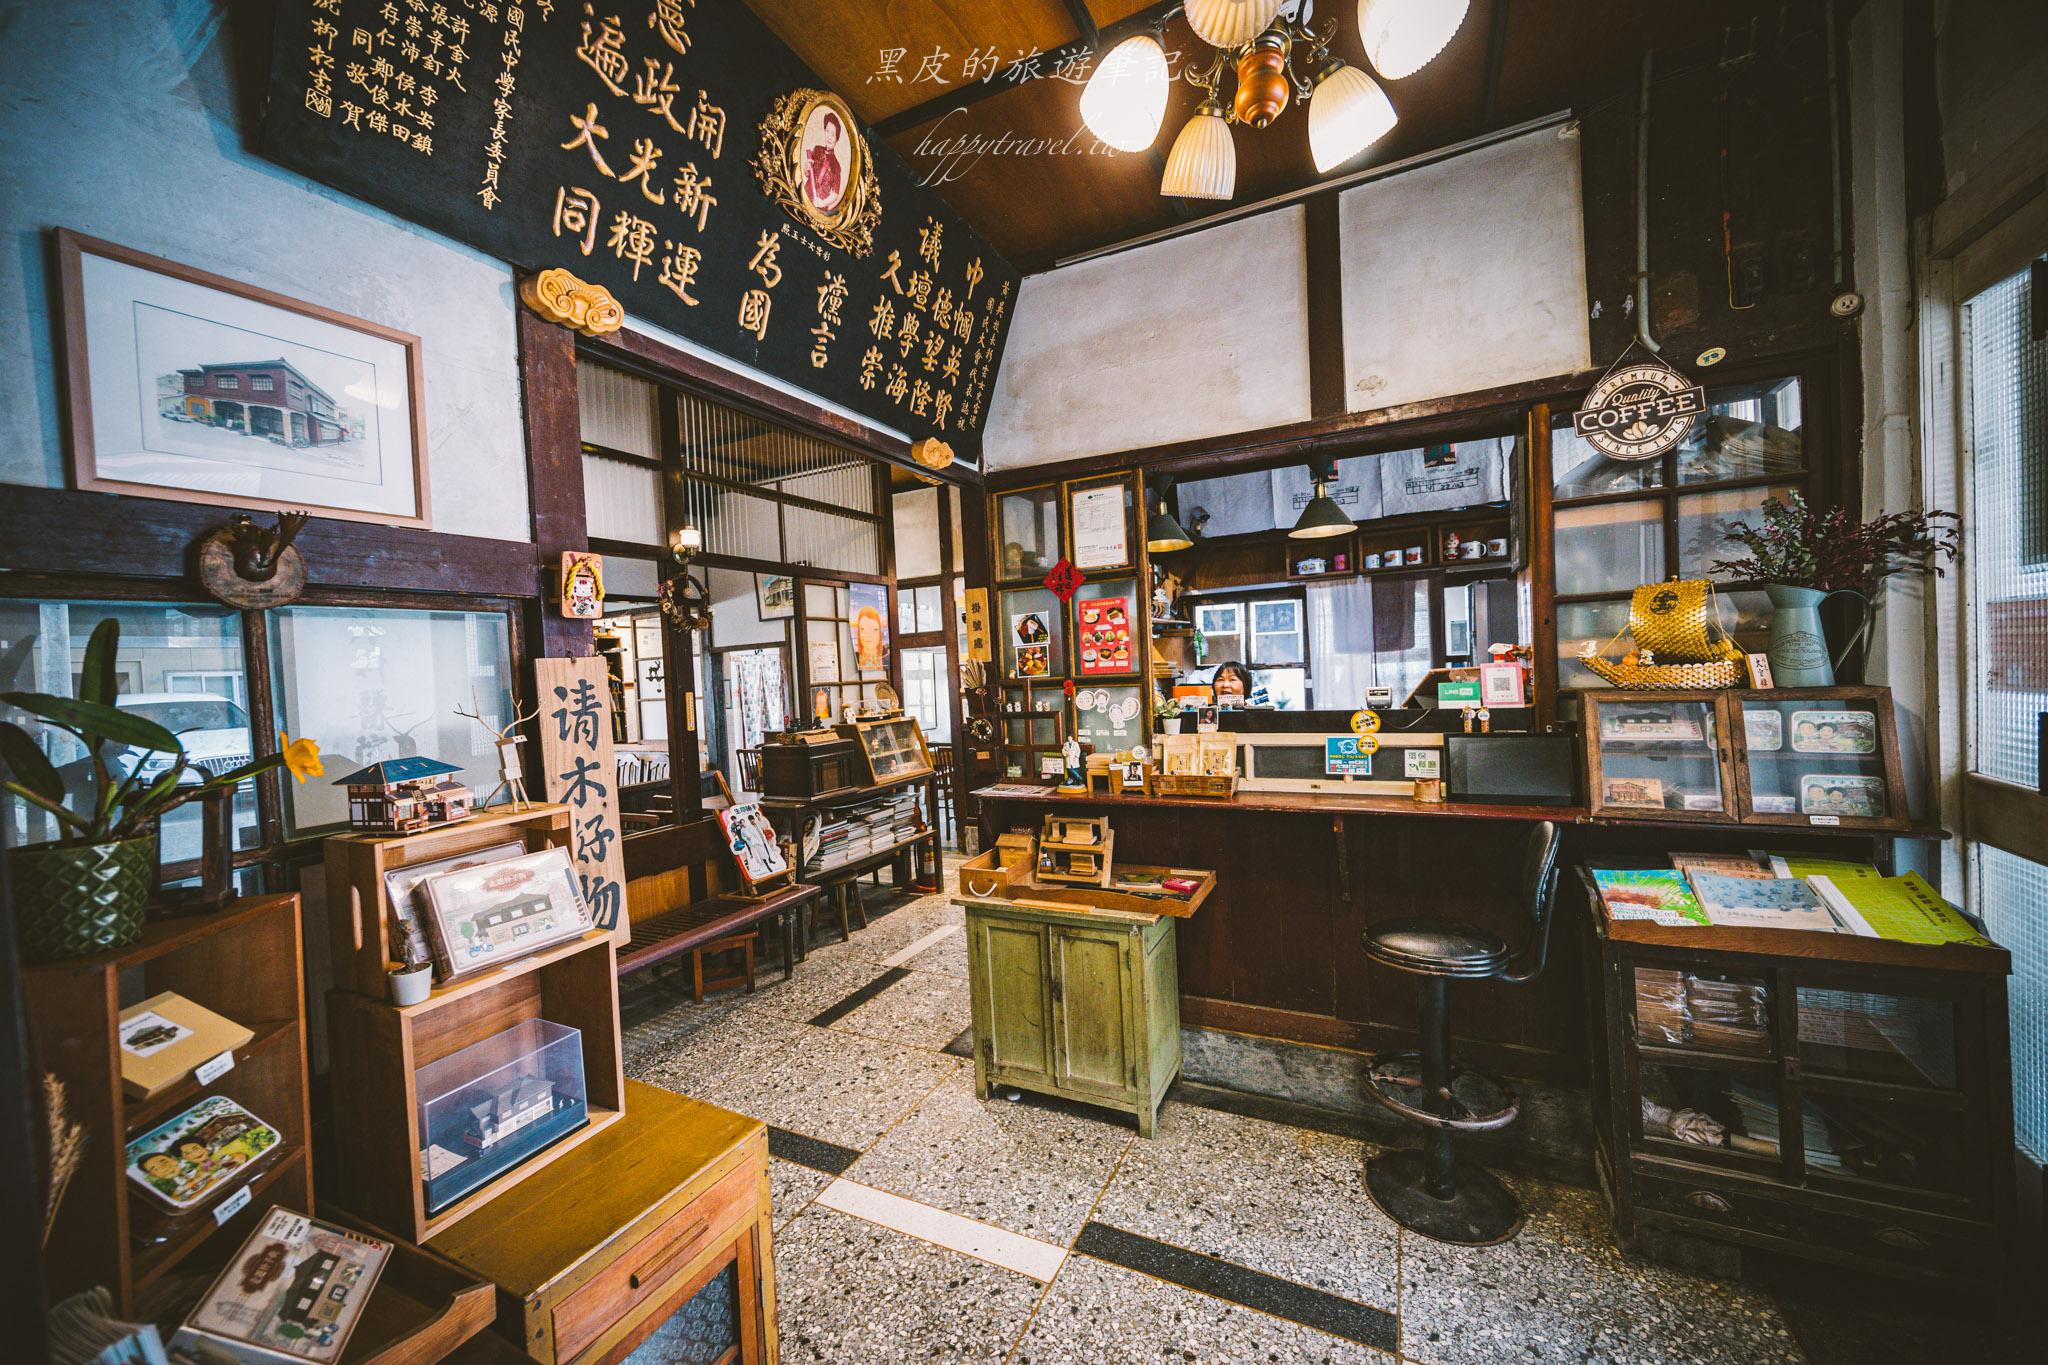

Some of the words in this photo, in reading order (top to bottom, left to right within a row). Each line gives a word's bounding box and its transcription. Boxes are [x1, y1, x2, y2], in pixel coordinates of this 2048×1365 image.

[339, 27, 373, 132] 同敬賀
[476, 0, 525, 210] 國民中學家長委員會
[657, 90, 727, 306] 開新運
[909, 287, 952, 417] 德望隆
[932, 256, 984, 431] 巾幗英賢
[1601, 371, 1668, 395] PREMIUM
[1580, 392, 1697, 431] COFFEE
[1598, 435, 1643, 455] SINCE
[1611, 387, 1661, 408] Quality
